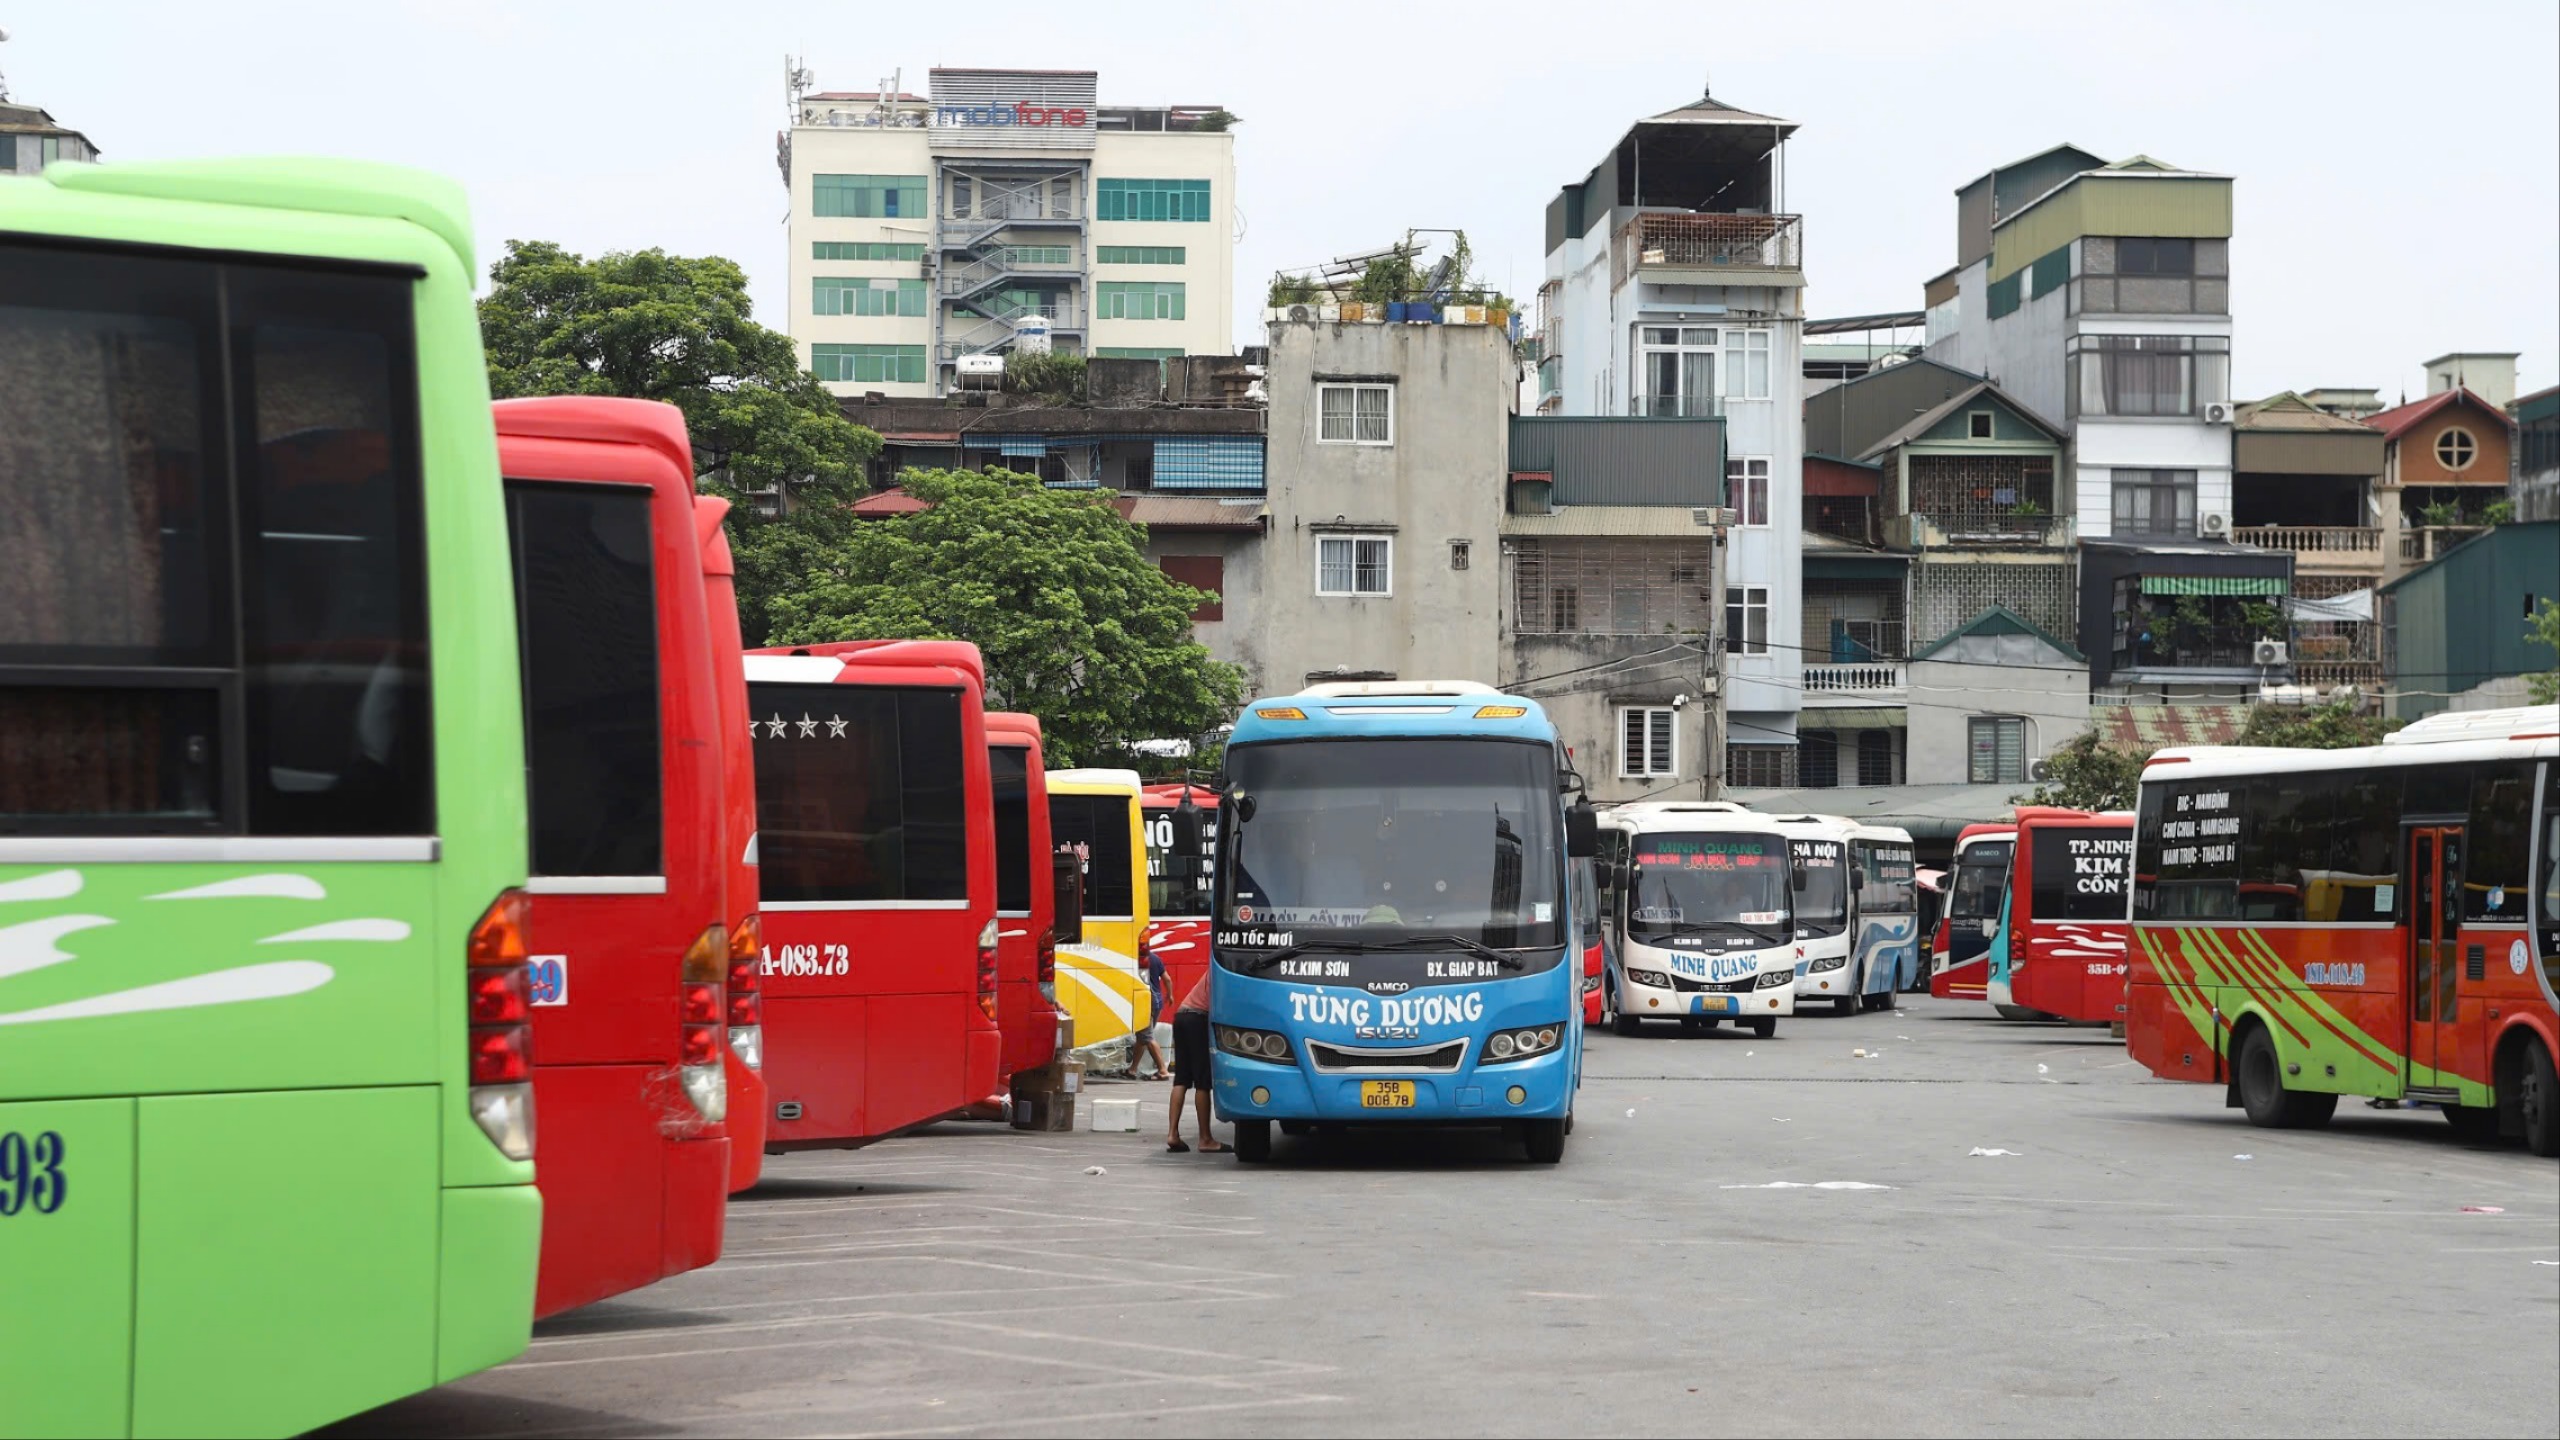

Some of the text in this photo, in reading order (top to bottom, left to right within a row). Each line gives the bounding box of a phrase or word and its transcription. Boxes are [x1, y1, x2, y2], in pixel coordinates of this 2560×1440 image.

[936, 100, 1087, 127] mobifone
[1658, 842, 1763, 855] MINH QUANG
[1793, 842, 1837, 859] HÀ NỘI
[2074, 857, 2123, 874] KIM
[2077, 873, 2120, 894] CỒN
[1217, 932, 1239, 946] CAO
[1241, 928, 1265, 946] TỐC
[760, 943, 850, 977] A-083.73
[1325, 959, 1350, 977] SƠN
[1671, 953, 1758, 983] MINH QUANG
[2087, 963, 2128, 976] 35B-0
[1367, 982, 1410, 992] SAMCO
[1289, 986, 1484, 1027] TÙNG DƯƠNG
[1355, 1026, 1420, 1040] ISUZU
[1376, 1082, 1400, 1094] 35B
[0, 1131, 68, 1217] 93
